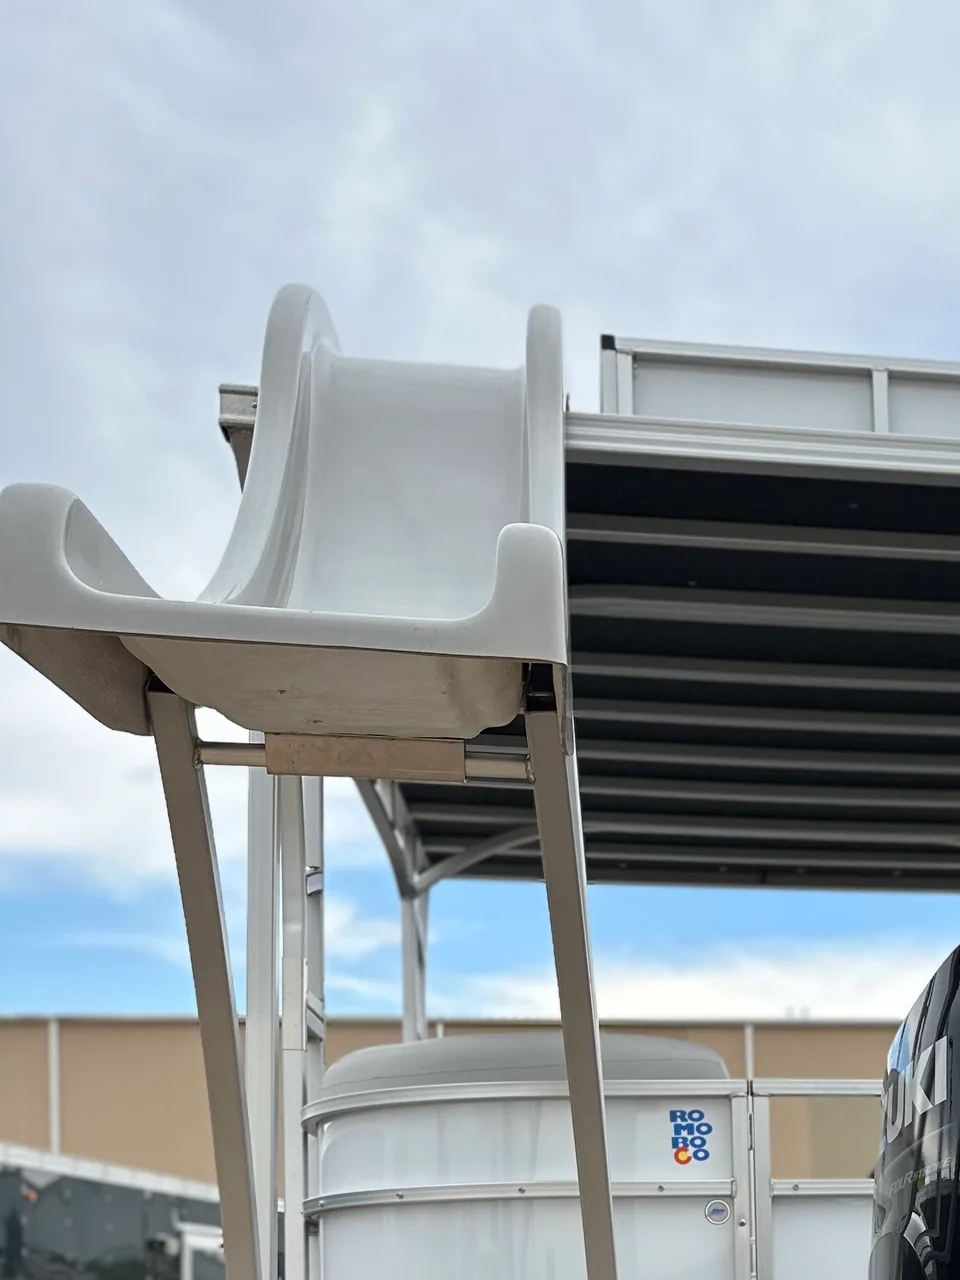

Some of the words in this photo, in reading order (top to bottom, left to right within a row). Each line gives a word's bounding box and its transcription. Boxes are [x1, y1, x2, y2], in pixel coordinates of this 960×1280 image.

[884, 1035, 948, 1144] UKI
[669, 1109, 705, 1123] RO
[673, 1122, 713, 1136] MO
[671, 1136, 707, 1149] BO
[674, 1147, 710, 1165] CO
